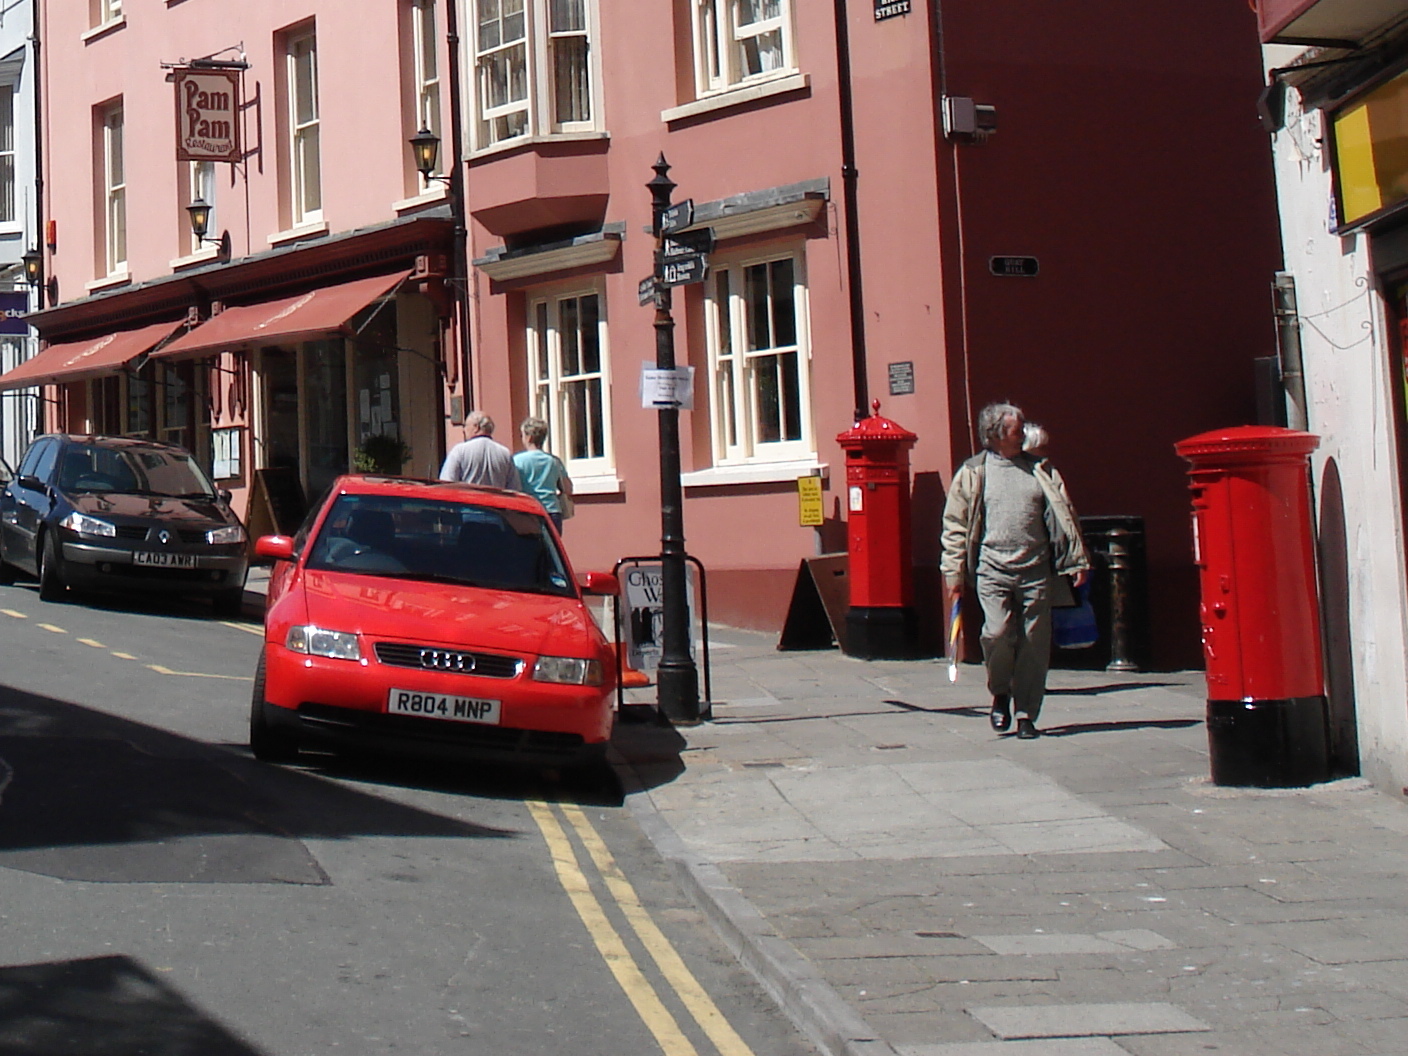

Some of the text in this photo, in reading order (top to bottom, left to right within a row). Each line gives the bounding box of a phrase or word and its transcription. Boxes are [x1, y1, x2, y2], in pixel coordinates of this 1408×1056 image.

[875, 1, 909, 19] STREET
[184, 80, 229, 111] Pam
[187, 108, 230, 138] Pam
[185, 138, 233, 153] Restaurant
[628, 570, 663, 587] Ghos
[397, 692, 492, 720] R804 MNP
